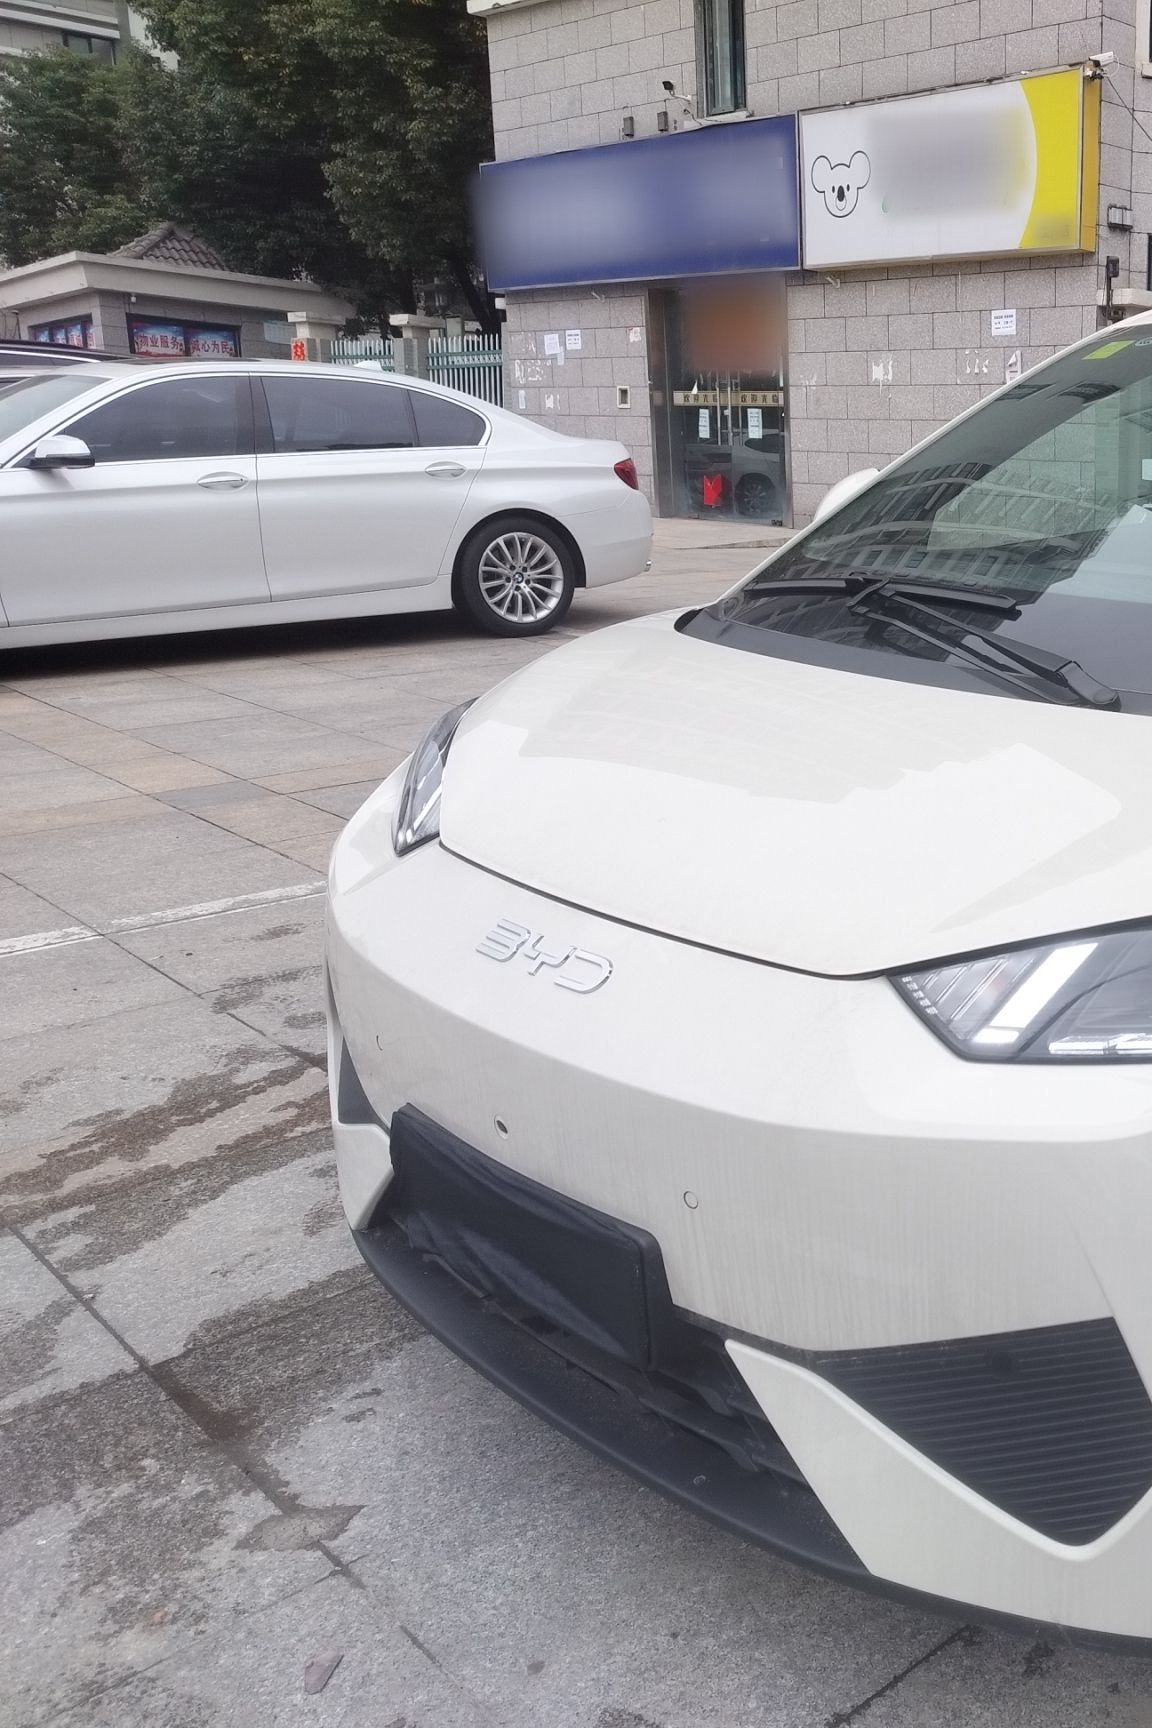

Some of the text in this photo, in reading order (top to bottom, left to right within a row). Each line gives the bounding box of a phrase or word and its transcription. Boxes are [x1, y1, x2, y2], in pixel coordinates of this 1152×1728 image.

[139, 333, 179, 350] 物业服务
[475, 918, 615, 995] BYD
